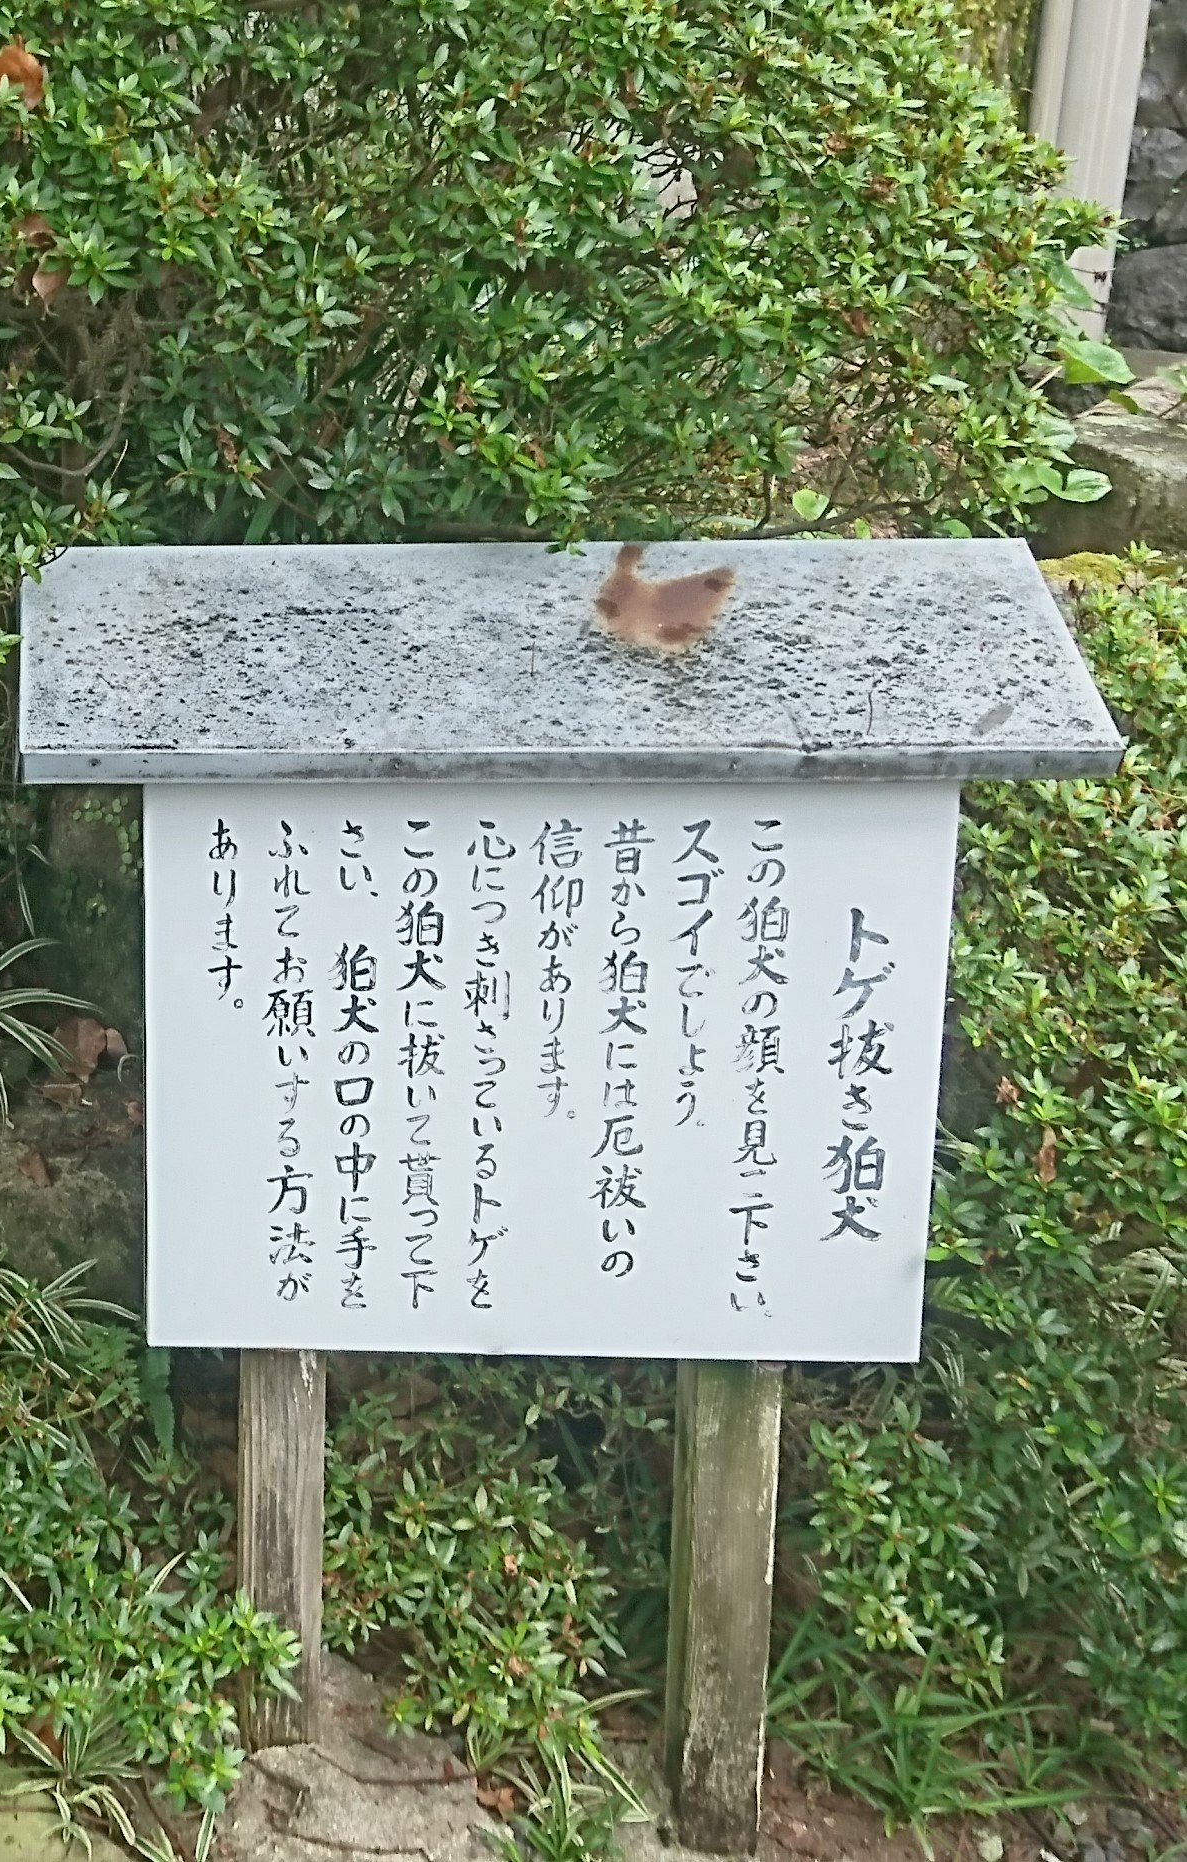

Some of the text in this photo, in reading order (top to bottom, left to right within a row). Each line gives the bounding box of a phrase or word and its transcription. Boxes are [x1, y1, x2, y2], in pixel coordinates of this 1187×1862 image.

[208, 818, 244, 1010] あります。
[262, 820, 317, 1302] ふれてお願いする方法が
[395, 821, 447, 1310] この狛犬に抜いて貰って下
[463, 820, 517, 1310] 心につき刺さっているトゲを
[529, 819, 585, 1120] 信仰があります。
[588, 819, 656, 1278] 昔から狛犬には厄祓いの
[819, 906, 896, 1242] トゲ抜き狛犬
